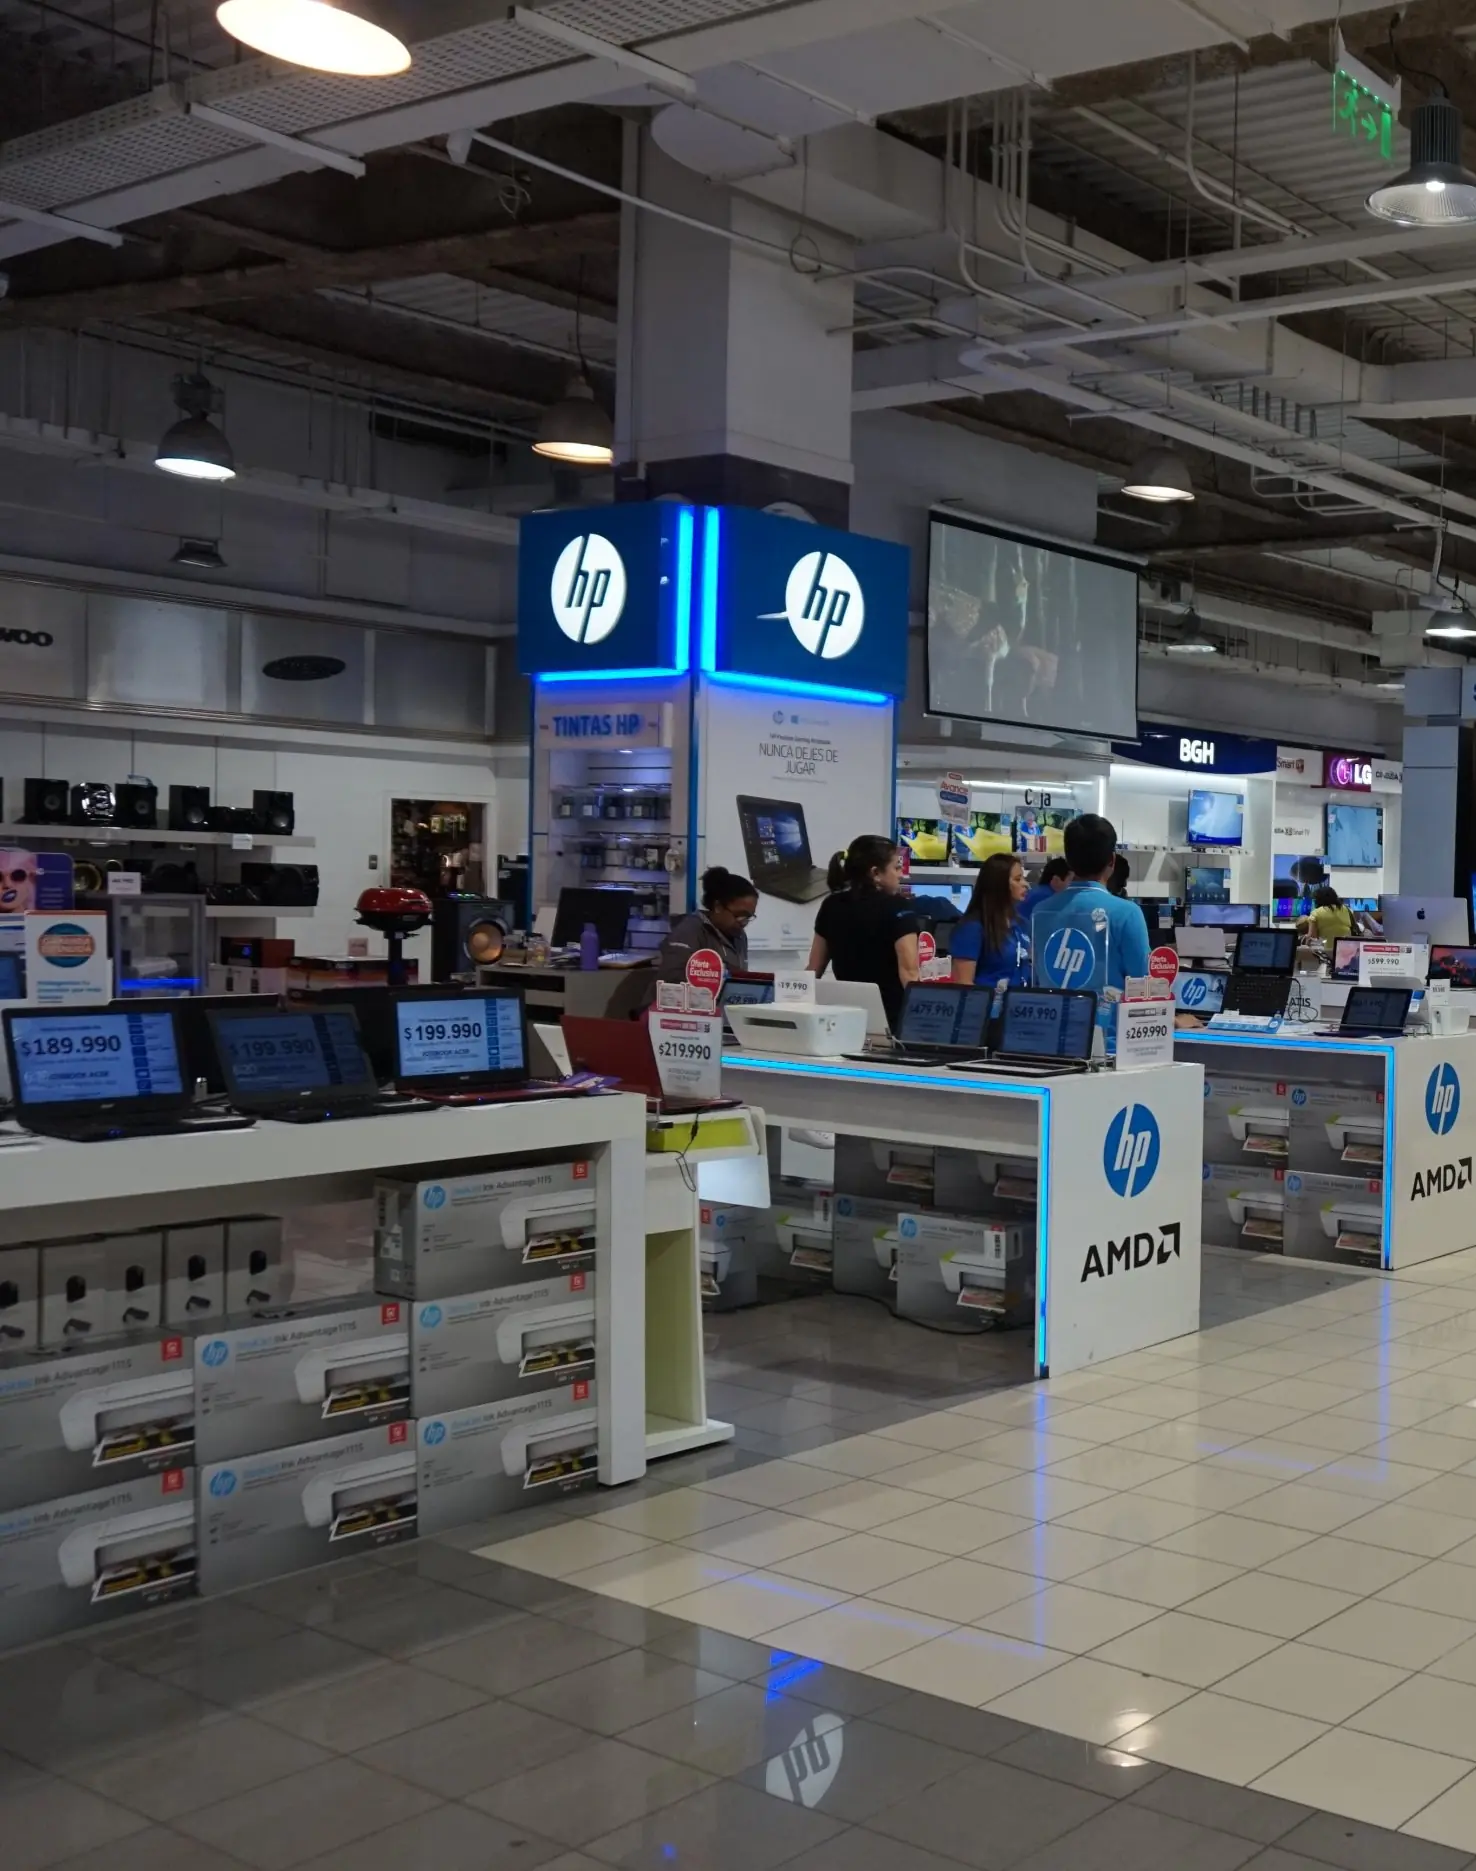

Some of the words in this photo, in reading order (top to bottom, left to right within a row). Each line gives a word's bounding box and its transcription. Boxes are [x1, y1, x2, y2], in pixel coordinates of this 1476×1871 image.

[564, 533, 612, 644] hp
[800, 551, 851, 658] hp
[552, 715, 613, 738] TINTAS
[616, 713, 641, 736] HP
[759, 742, 793, 758] NUNCA
[795, 746, 824, 762] DEJES
[826, 749, 838, 762] DE
[1179, 737, 1214, 765] BGH
[785, 760, 816, 775] JUGAR
[1354, 763, 1372, 785] LG
[690, 959, 709, 968] Oferta
[1052, 927, 1086, 988] hp
[1150, 962, 1176, 970] Exclusiva
[689, 967, 719, 978] Exclusiva
[1183, 977, 1206, 1007] hp
[1290, 997, 1311, 1007] ATIS
[1125, 1024, 1168, 1040] $269.990
[20, 1034, 122, 1057] $189.990
[658, 1041, 711, 1060] $219.990
[1430, 1062, 1455, 1136] hp
[1112, 1103, 1151, 1198] hp
[1410, 1161, 1458, 1201] AMD
[425, 1185, 445, 1209] hp
[1080, 1229, 1155, 1284] AMD
[421, 1304, 441, 1328] hp
[289, 1324, 338, 1341] Advantage
[204, 1340, 228, 1366] hp
[54, 1362, 110, 1381] Advantage
[496, 1403, 537, 1419] Advantage
[425, 1421, 446, 1445] hp
